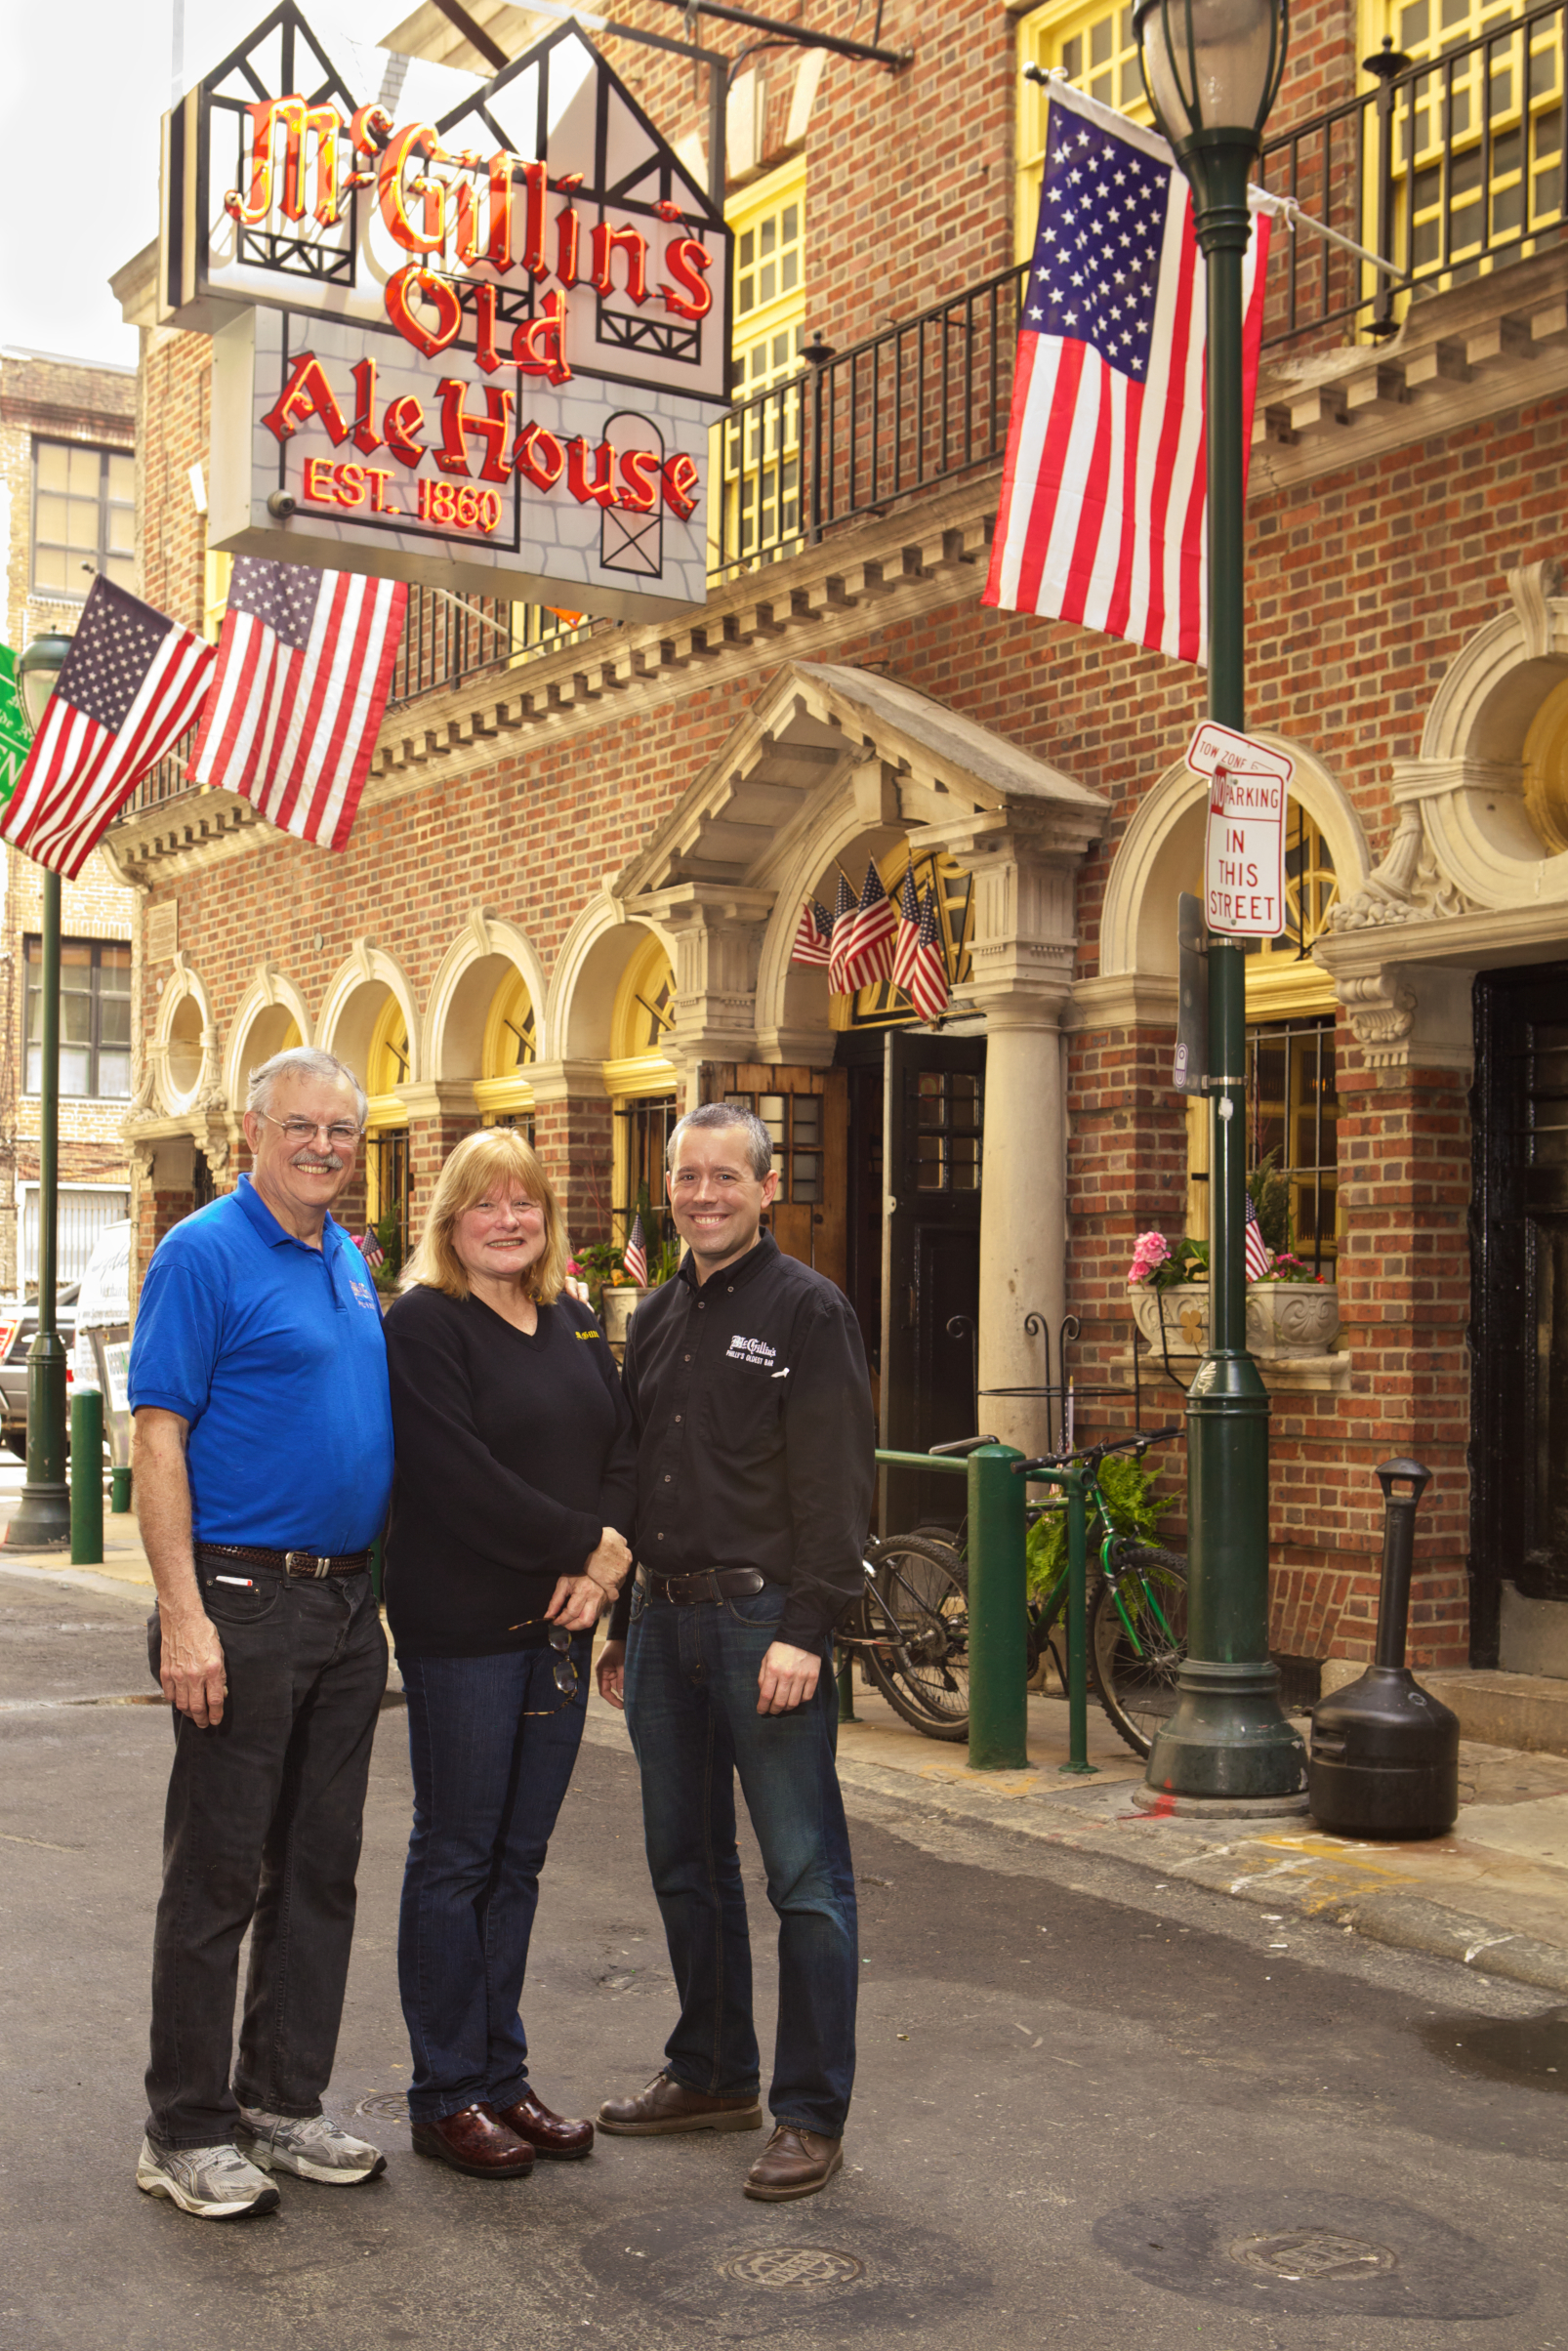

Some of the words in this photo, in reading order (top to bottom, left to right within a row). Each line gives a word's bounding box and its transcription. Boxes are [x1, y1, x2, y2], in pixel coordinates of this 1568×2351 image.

[385, 261, 573, 387] Old
[417, 477, 504, 534] 1860
[1199, 740, 1219, 759] TOW
[1212, 774, 1226, 808] NO
[1225, 785, 1279, 808] PARKING
[1226, 829, 1245, 853] IN
[1218, 859, 1259, 887] THIS
[1211, 890, 1275, 921] STREET
[745, 1354, 763, 1365] OLDEST
[763, 1358, 774, 1367] BAR
